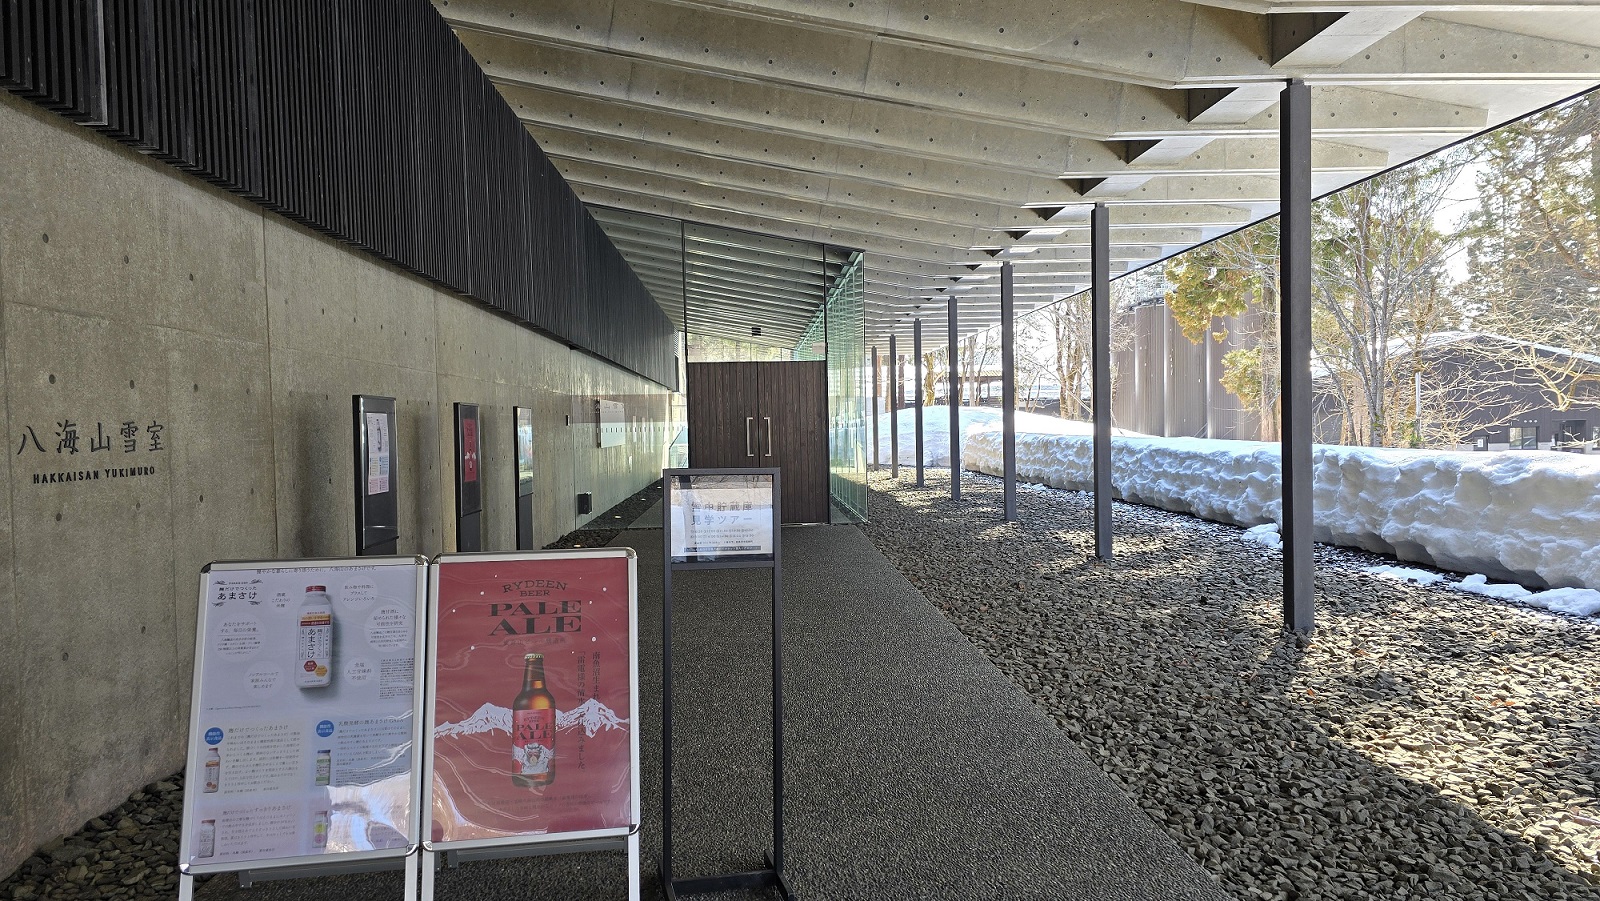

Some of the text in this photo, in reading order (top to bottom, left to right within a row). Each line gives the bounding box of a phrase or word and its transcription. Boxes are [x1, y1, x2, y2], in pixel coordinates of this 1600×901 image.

[17, 419, 165, 455] 八海山雪室
[33, 466, 156, 484] HAKKAISAN YUKIMURO
[691, 514, 752, 525] 見学ツアー
[502, 579, 568, 593] RYDEEN
[217, 591, 258, 600] あまさけ
[488, 600, 582, 617] PALE
[488, 616, 582, 636] ALE
[516, 723, 552, 731] PALE
[517, 730, 553, 740] ALE
